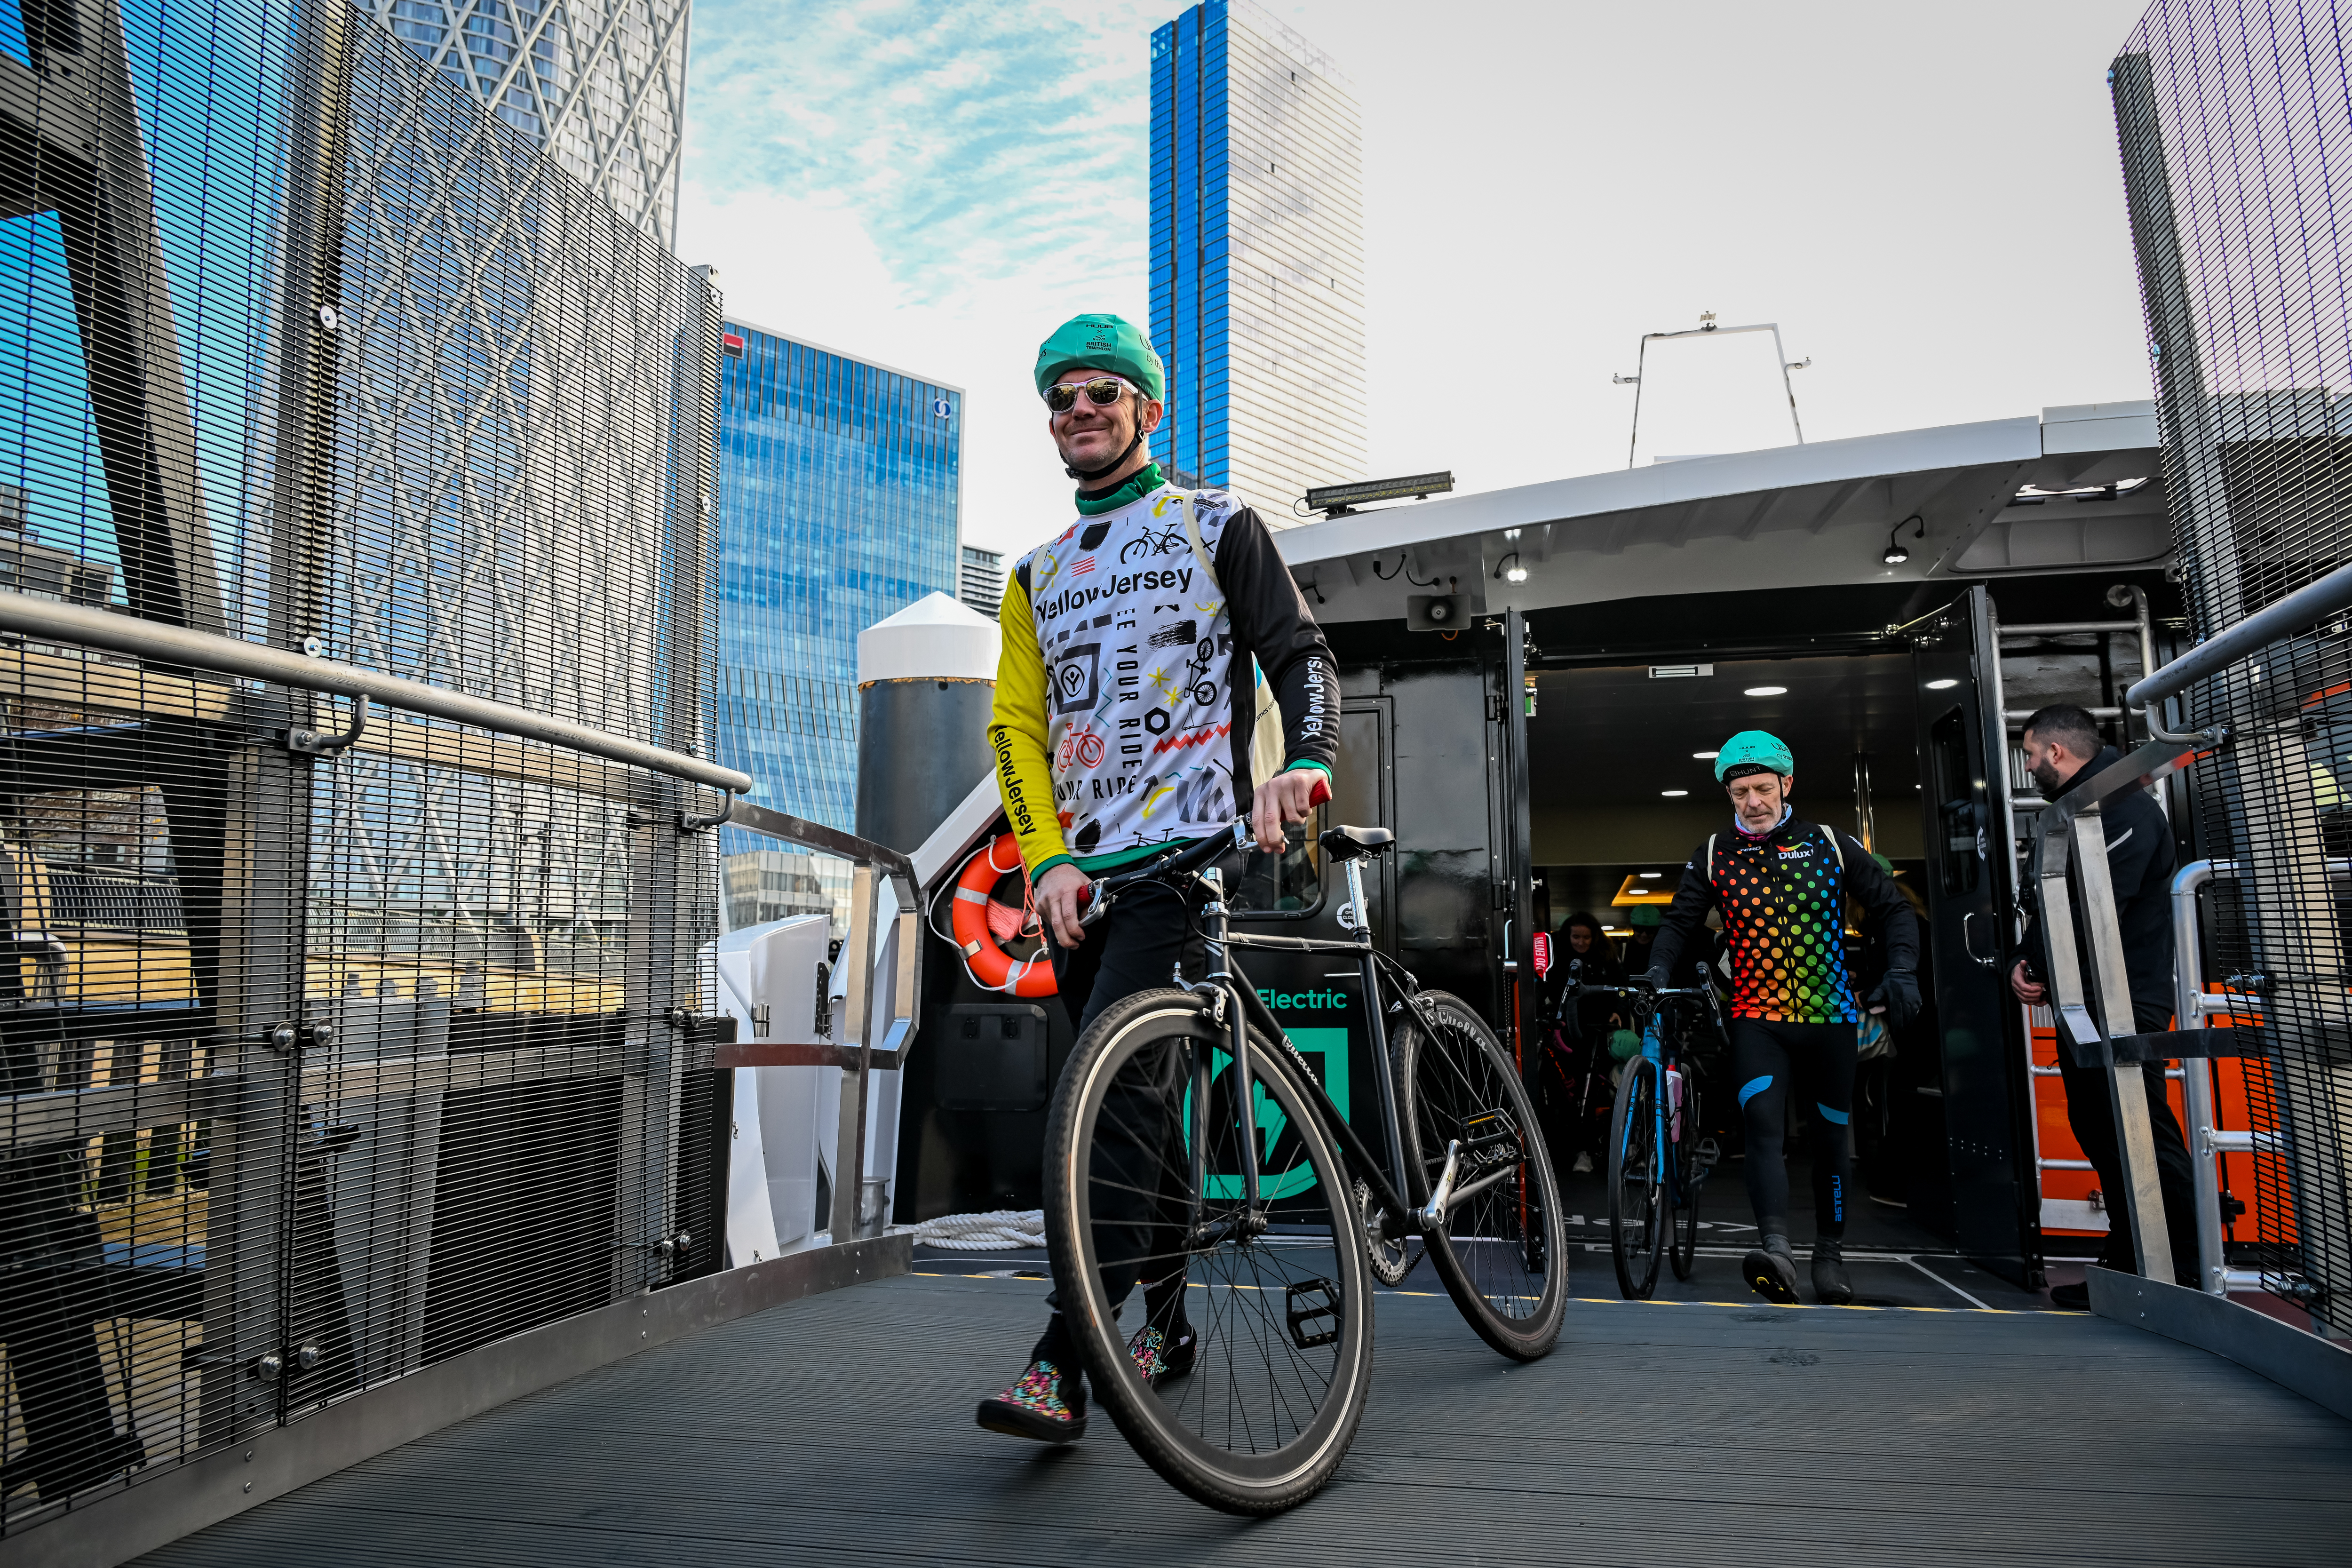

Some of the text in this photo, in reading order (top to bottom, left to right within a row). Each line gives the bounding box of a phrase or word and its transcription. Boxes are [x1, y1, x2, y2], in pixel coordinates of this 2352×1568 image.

[1146, 352, 1154, 366] by
[1035, 567, 1193, 625] YellowJersey
[1116, 644, 1139, 703] YOUR
[1300, 656, 1326, 741] YellowJers
[1119, 717, 1143, 770] RIDE
[1092, 774, 1137, 800] RIDE
[1737, 765, 1760, 776] HUNT
[1778, 850, 1812, 860] Dulux
[1534, 937, 1546, 970] NO ENTRY
[1256, 988, 1347, 1009] Electric
[1438, 1011, 1487, 1051] Quella
